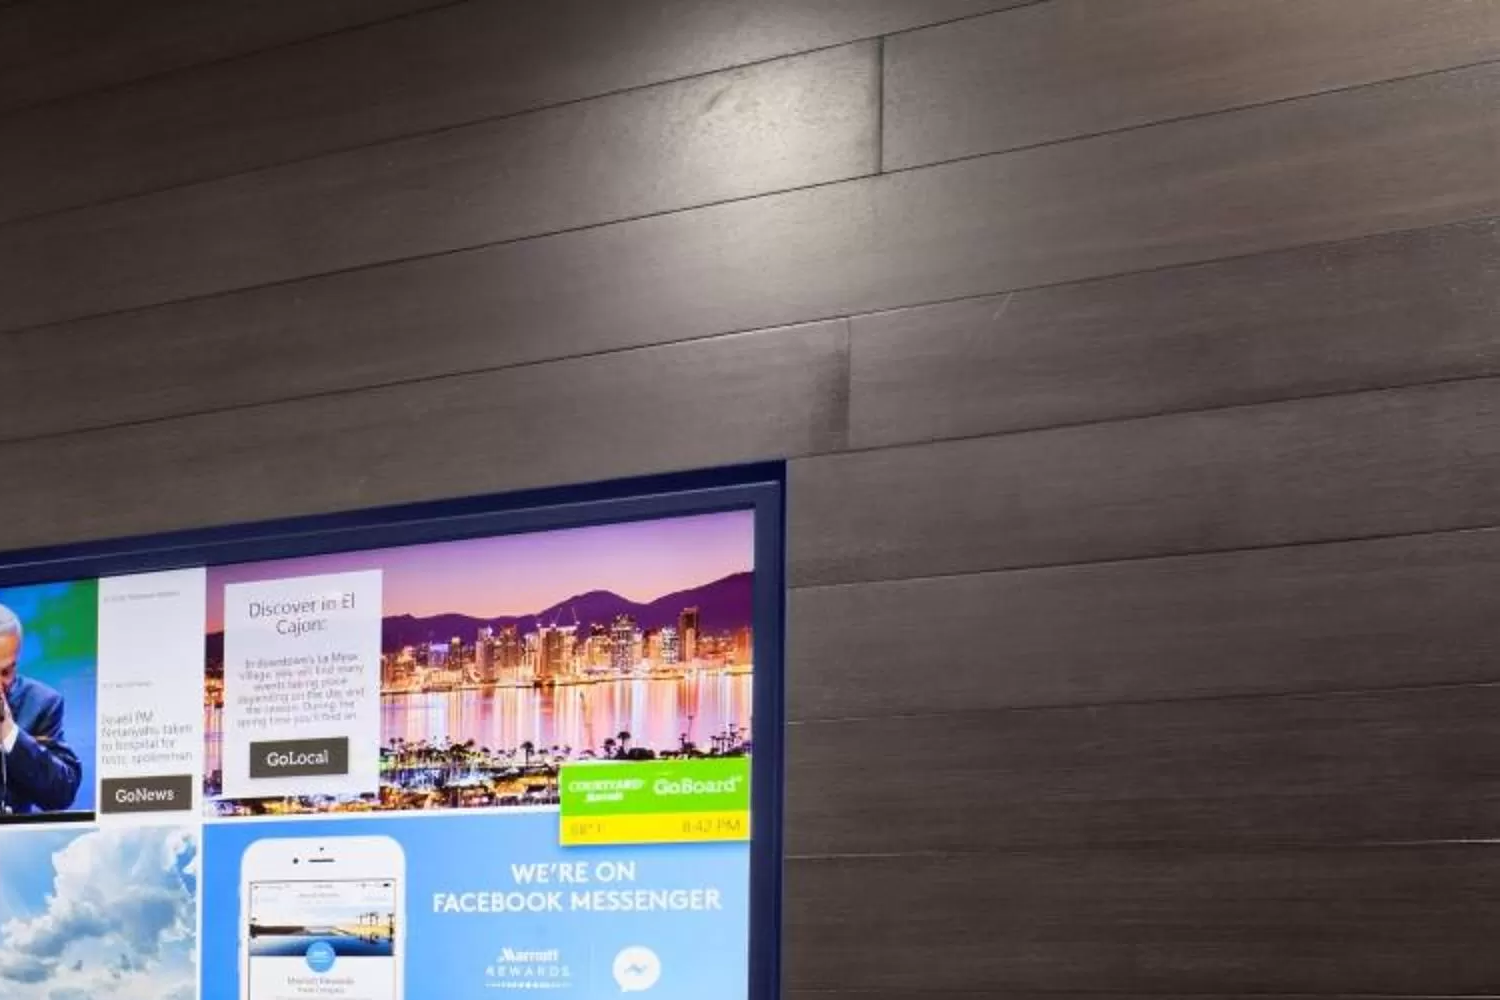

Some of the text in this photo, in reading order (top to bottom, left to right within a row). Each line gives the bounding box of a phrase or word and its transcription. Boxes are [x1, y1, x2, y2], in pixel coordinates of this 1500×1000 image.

[250, 592, 355, 618] Discover in El
[266, 750, 329, 767] GoLocal
[115, 787, 175, 804] GoNews
[717, 818, 741, 833] PM
[511, 860, 637, 885] WE'RE ON
[432, 888, 723, 914] FACEBOOK MESSENGER
[496, 946, 558, 964] Marriott
[485, 964, 572, 978] REWARDS
